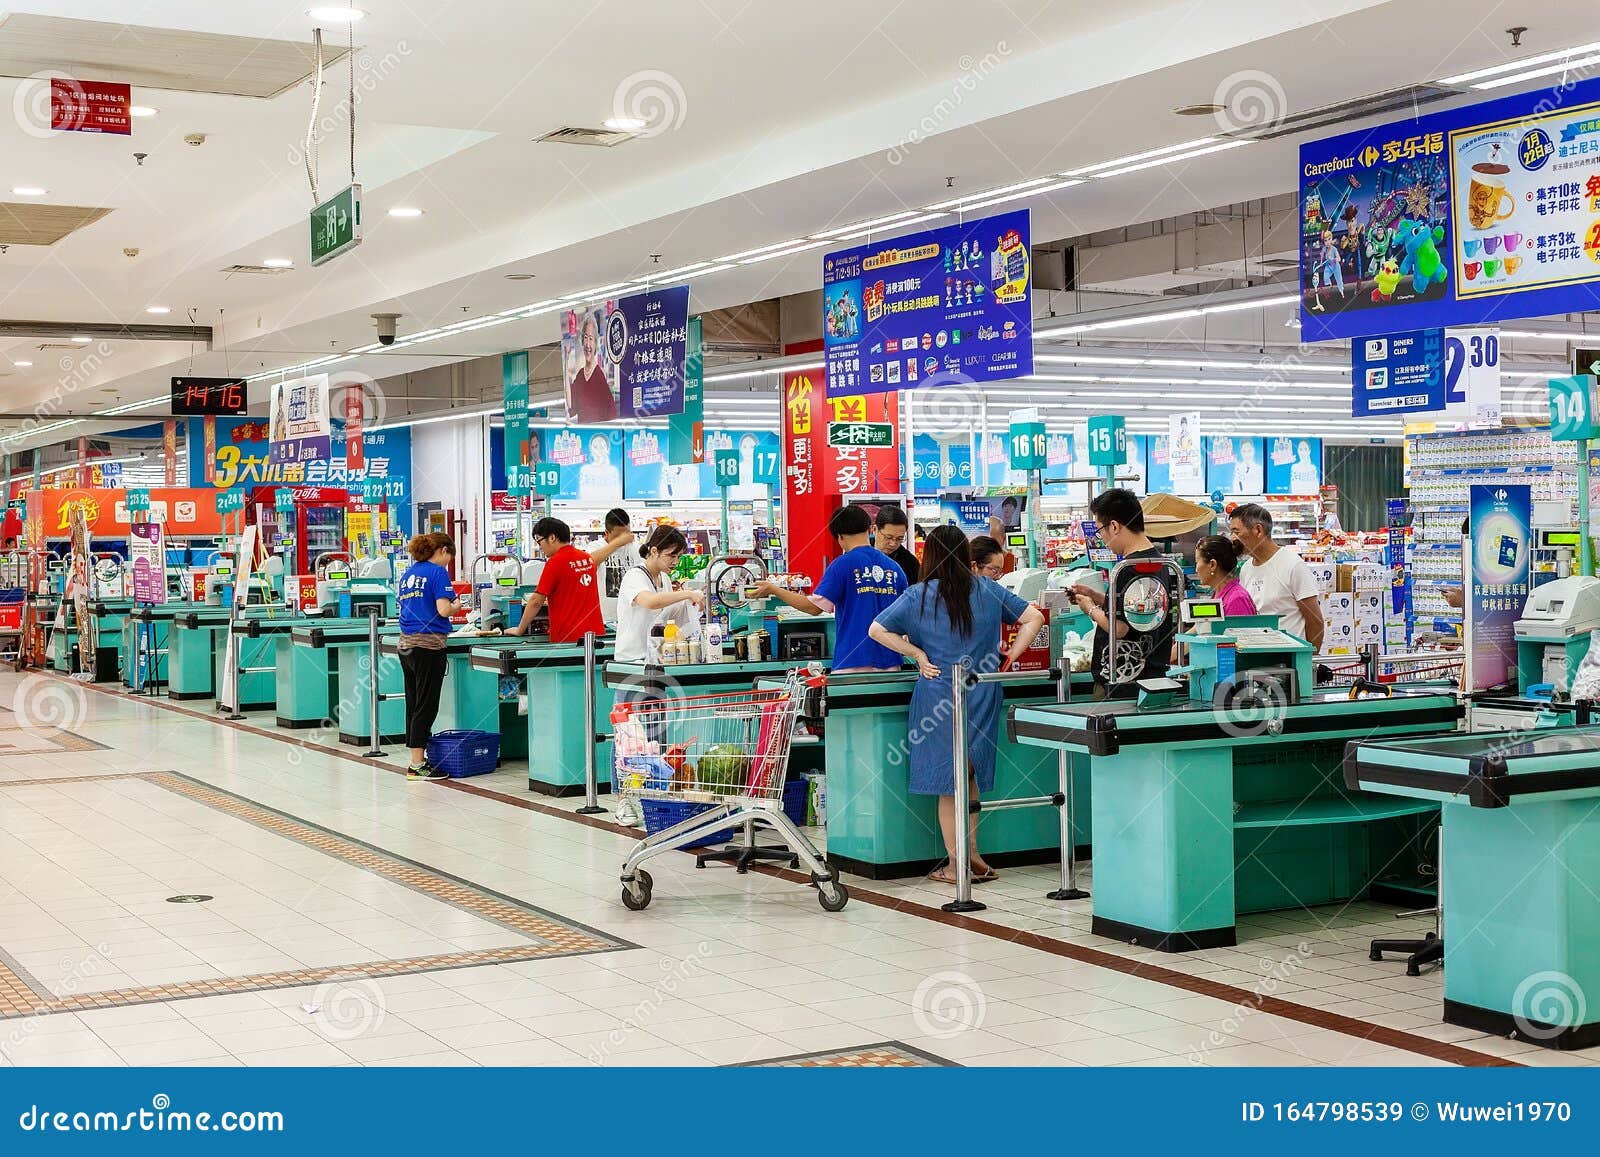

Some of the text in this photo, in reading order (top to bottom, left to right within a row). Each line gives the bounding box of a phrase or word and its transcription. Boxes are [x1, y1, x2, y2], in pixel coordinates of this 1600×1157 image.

[1382, 132, 1444, 163] 家乐福
[1558, 140, 1599, 158] 迪士尼马
[1304, 155, 1355, 177] Carrefour
[1536, 182, 1581, 201] 集齐10枚
[1536, 197, 1581, 217] 电子印花
[1536, 231, 1576, 249] 集齐3枚
[1536, 246, 1581, 264] 电子印花
[885, 278, 921, 295] 消费满100元
[1393, 338, 1414, 347] DINERS
[1469, 335, 1498, 368] 30
[633, 346, 673, 366] 价格更透明
[220, 385, 243, 408] 16
[1552, 390, 1586, 424] 14
[1012, 434, 1046, 458] 16 16
[1090, 427, 1127, 452] 15 15
[717, 458, 738, 476] 18
[757, 452, 778, 476] 17
[508, 473, 530, 488] 20 20
[538, 471, 559, 486] 19
[860, 460, 869, 492] Saving
[372, 485, 383, 497] 22
[393, 482, 404, 496] 21
[140, 494, 149, 504] 25
[227, 493, 237, 505] 24
[282, 493, 293, 505] 23
